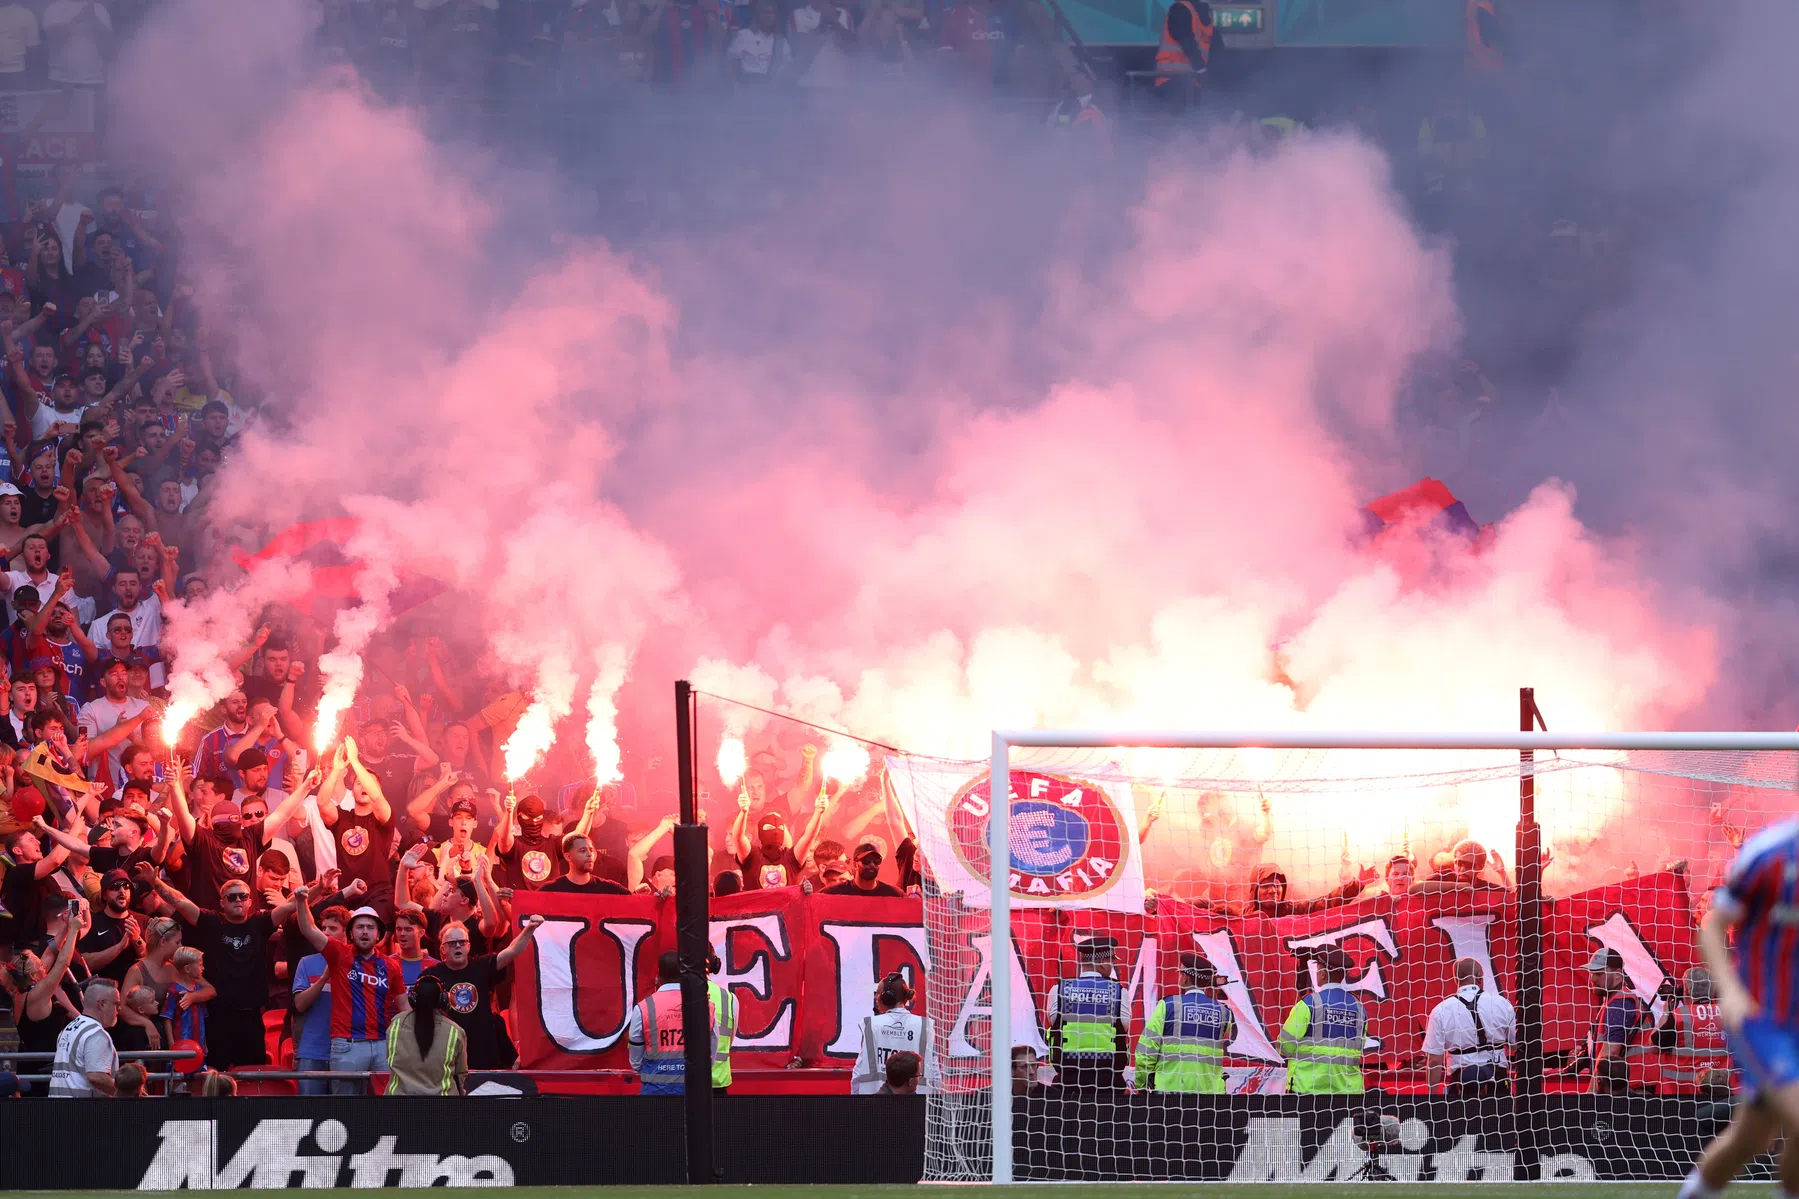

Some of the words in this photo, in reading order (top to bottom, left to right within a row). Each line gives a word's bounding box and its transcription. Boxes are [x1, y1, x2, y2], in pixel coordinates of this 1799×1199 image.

[18, 138, 79, 159] ACE
[358, 971, 388, 989] TDK
[452, 984, 473, 994] UEFA
[1071, 992, 1109, 1004] POLICE
[455, 1001, 476, 1012] MAFIA
[1187, 1012, 1219, 1026] POLICE
[1326, 1014, 1355, 1026] POLICE
[907, 1030, 914, 1041] 8
[137, 1118, 515, 1190] Mitre
